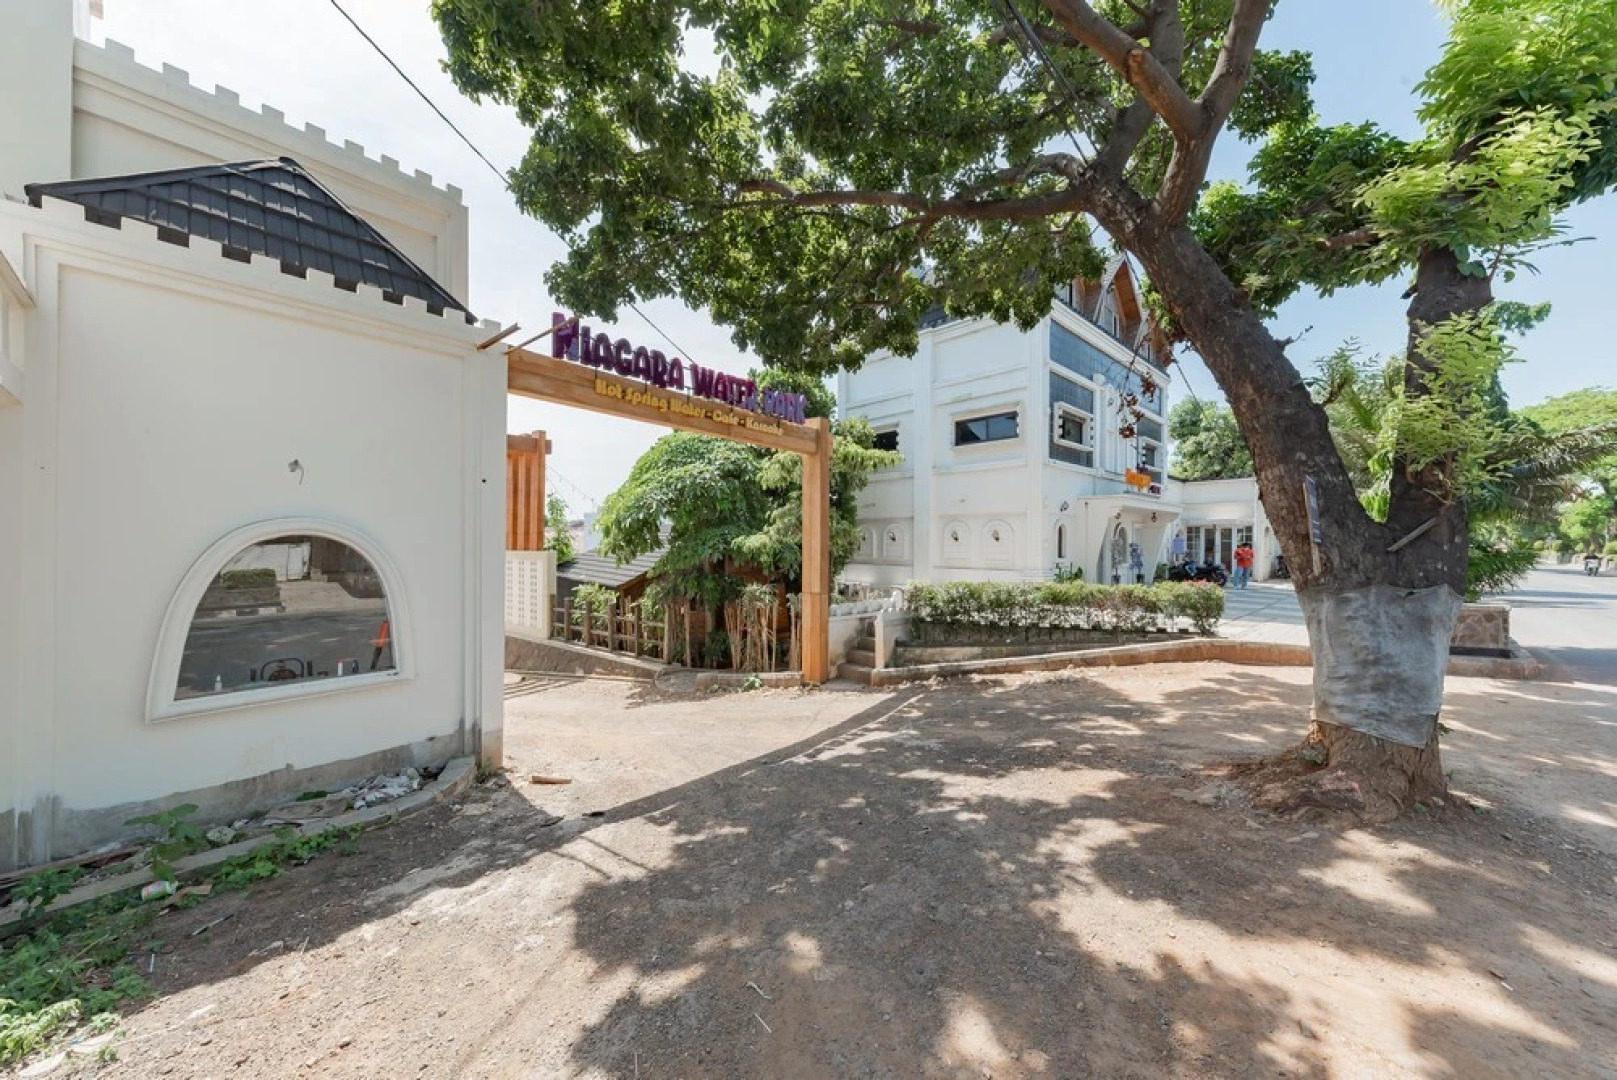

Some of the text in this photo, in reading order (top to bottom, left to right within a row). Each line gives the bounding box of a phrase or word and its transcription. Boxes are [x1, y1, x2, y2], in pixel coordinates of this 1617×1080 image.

[552, 311, 807, 425] NIAGARA WATER PARK
[594, 379, 622, 399] Hot
[625, 387, 668, 412] Spring
[669, 398, 706, 418] Water
